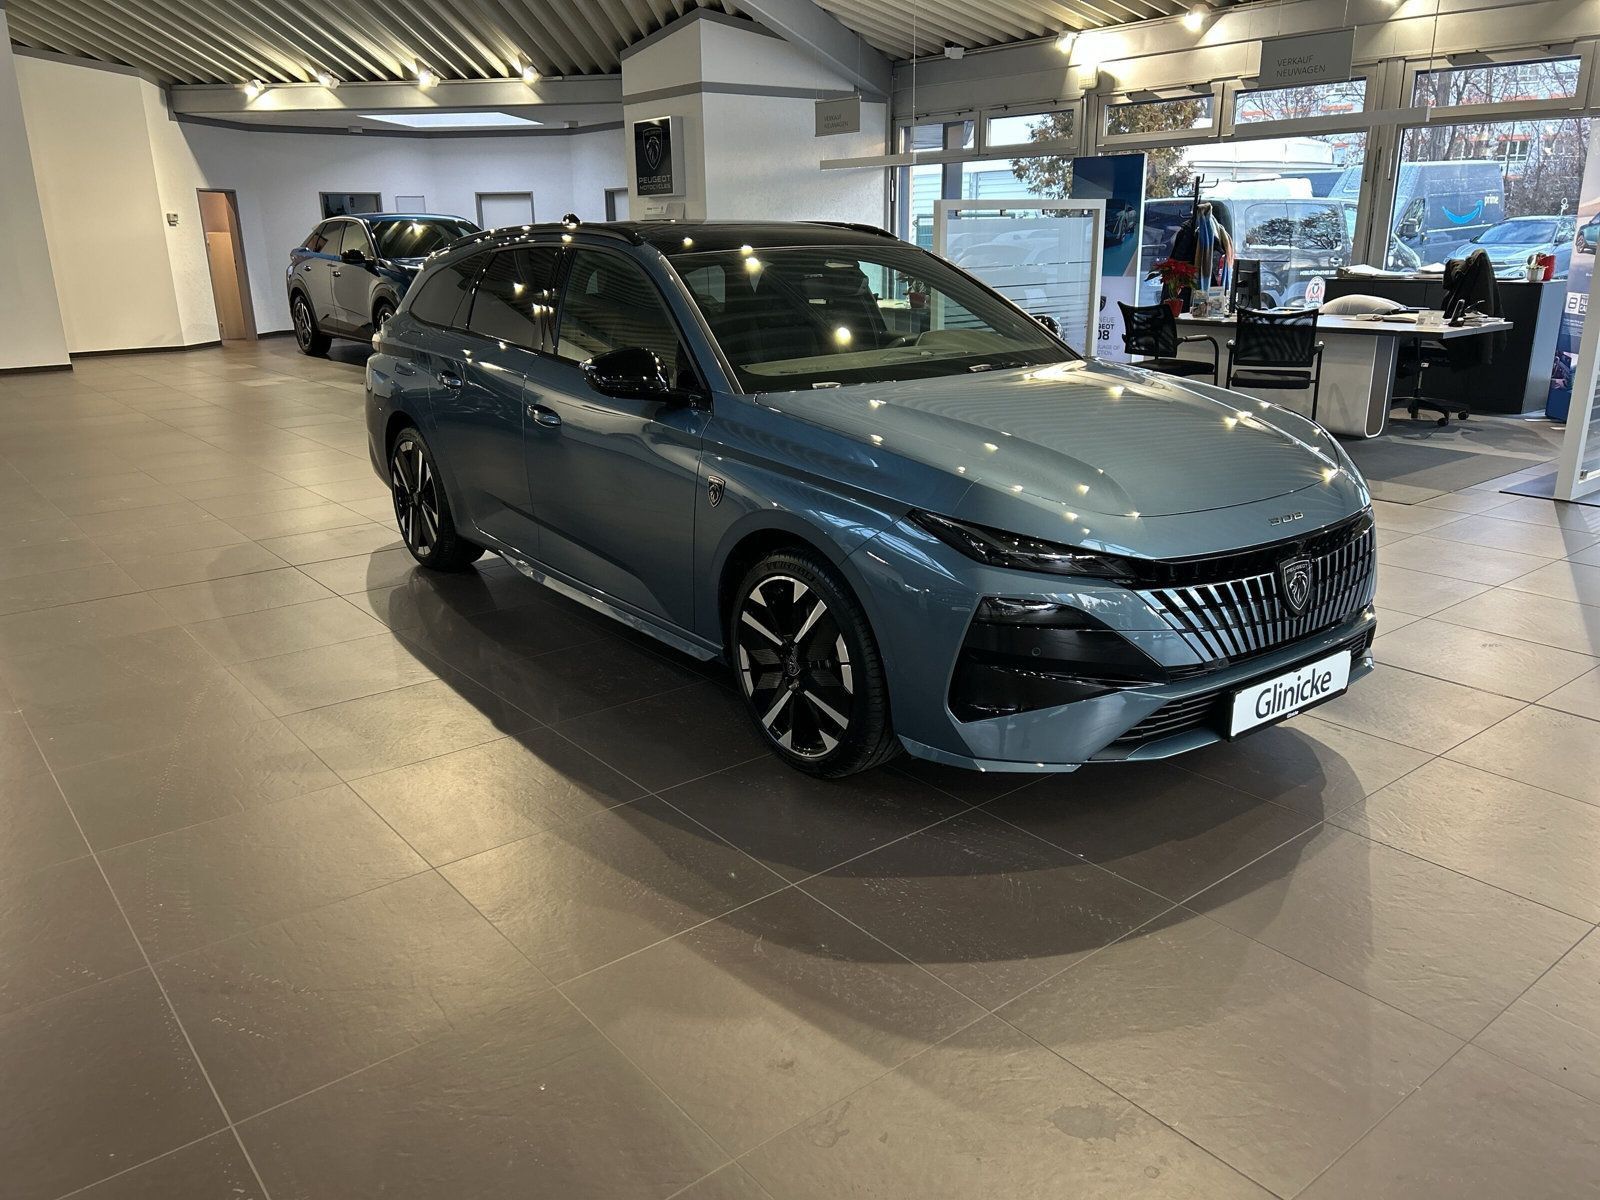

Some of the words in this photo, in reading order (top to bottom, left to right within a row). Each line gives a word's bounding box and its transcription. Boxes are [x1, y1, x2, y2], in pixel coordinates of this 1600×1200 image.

[1277, 54, 1314, 67] VERKAUF
[1276, 64, 1326, 77] NEUWAGEN
[638, 174, 672, 184] PEUGEOT
[639, 183, 672, 191] MOTOCYCLES
[1484, 193, 1499, 207] prime
[1286, 563, 1308, 574] PEUGEOT
[1255, 668, 1332, 719] Glinicke
